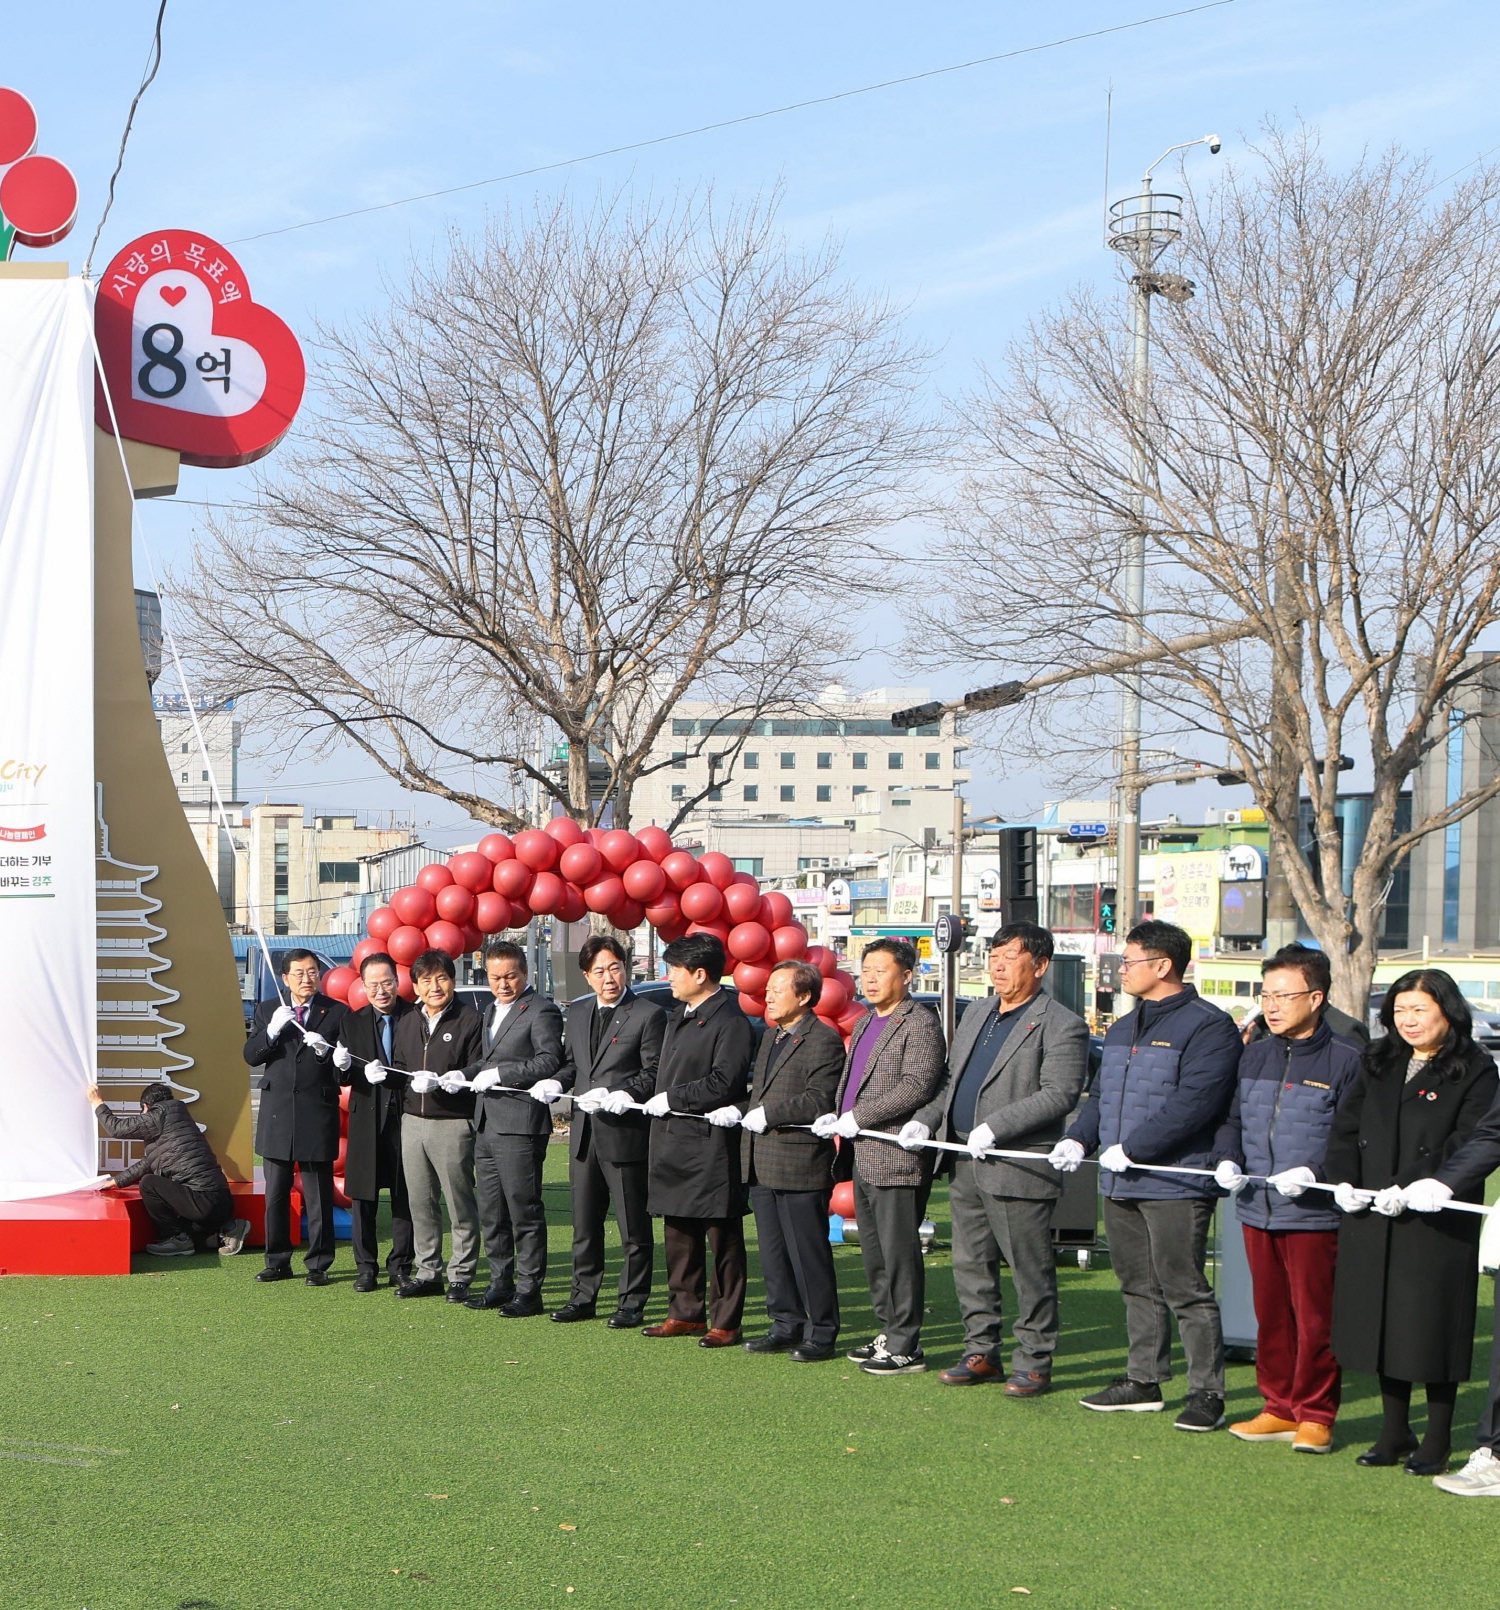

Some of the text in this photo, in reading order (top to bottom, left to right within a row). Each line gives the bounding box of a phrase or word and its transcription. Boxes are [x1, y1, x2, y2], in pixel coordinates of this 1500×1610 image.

[112, 239, 242, 305] 사랑의 목표액
[1, 759, 47, 788] City
[0, 856, 29, 868] 더하는
[32, 856, 52, 867] 기부
[0, 876, 30, 888] 바꾸는
[32, 875, 52, 887] 경주
